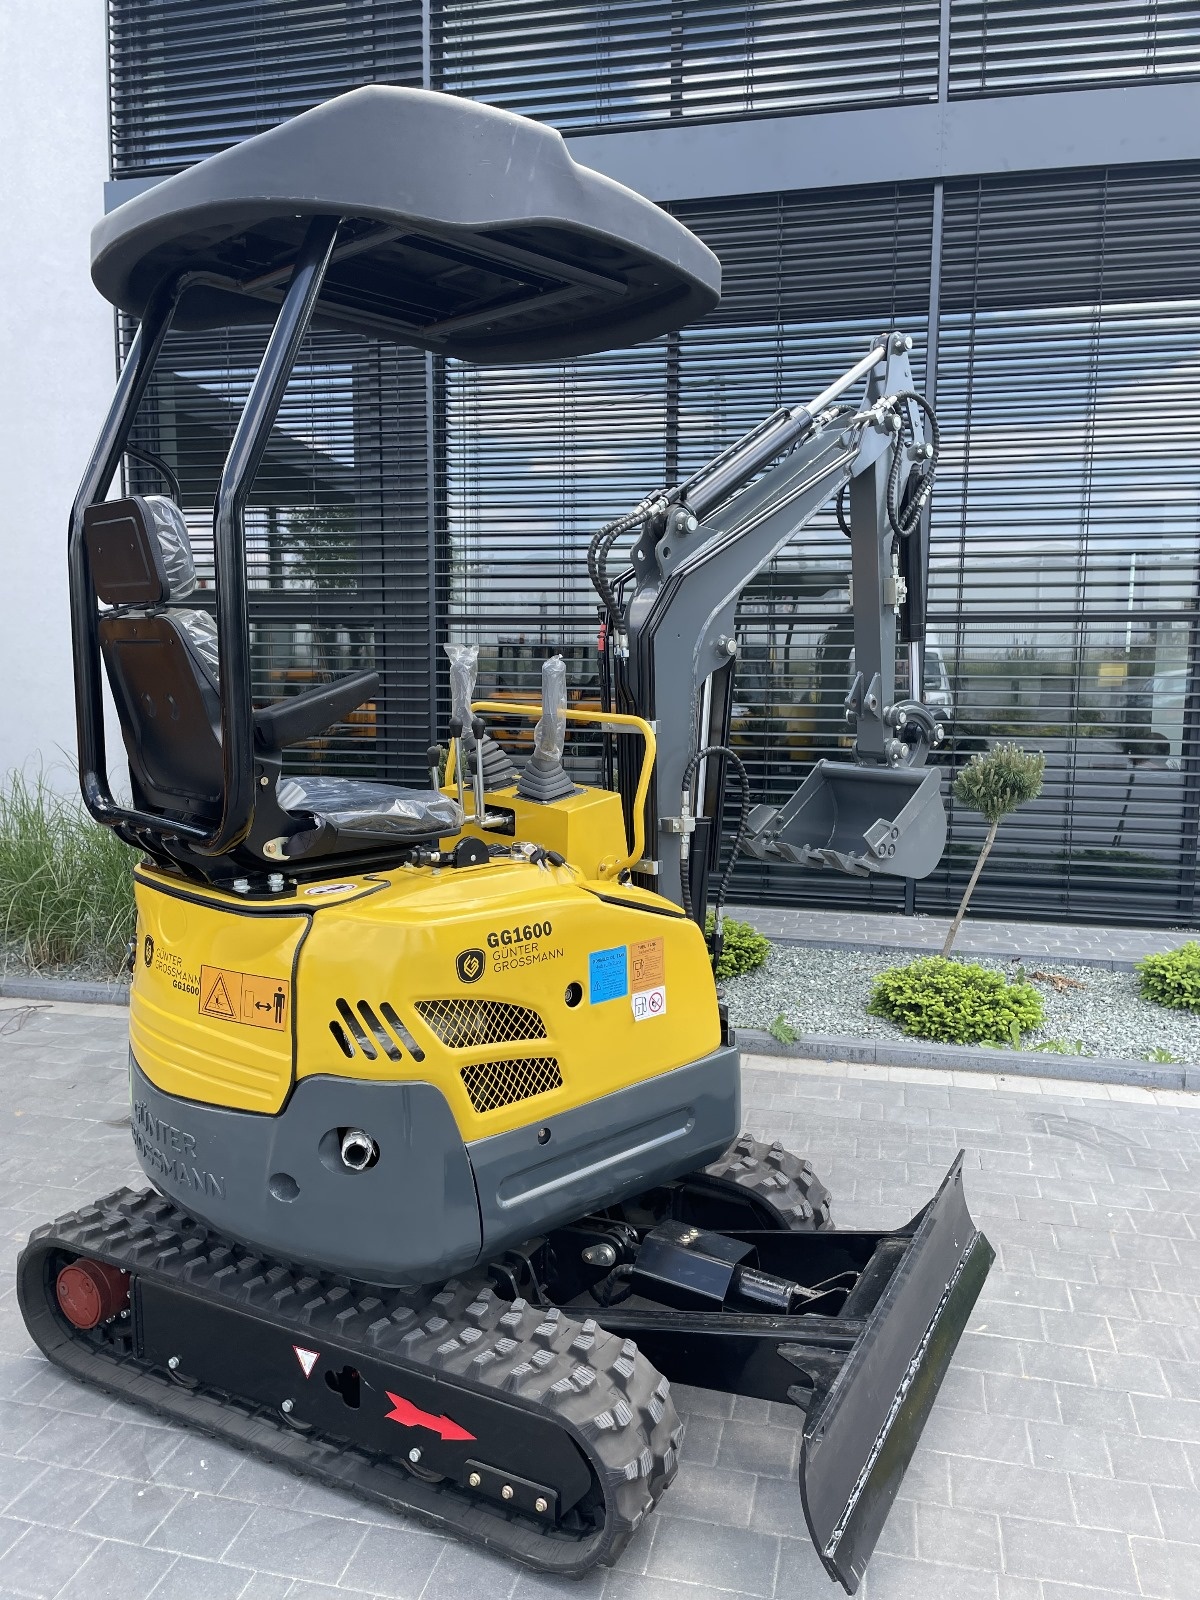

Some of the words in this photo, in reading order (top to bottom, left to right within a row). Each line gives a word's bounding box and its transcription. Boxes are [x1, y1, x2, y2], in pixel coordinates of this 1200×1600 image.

[486, 921, 553, 948] GG1600
[155, 947, 183, 968] GÜNTER
[492, 942, 539, 961] GÜNTER
[493, 948, 564, 973] GROSSMANN
[155, 959, 200, 985] GROSSMANN
[172, 979, 200, 996] GG1600
